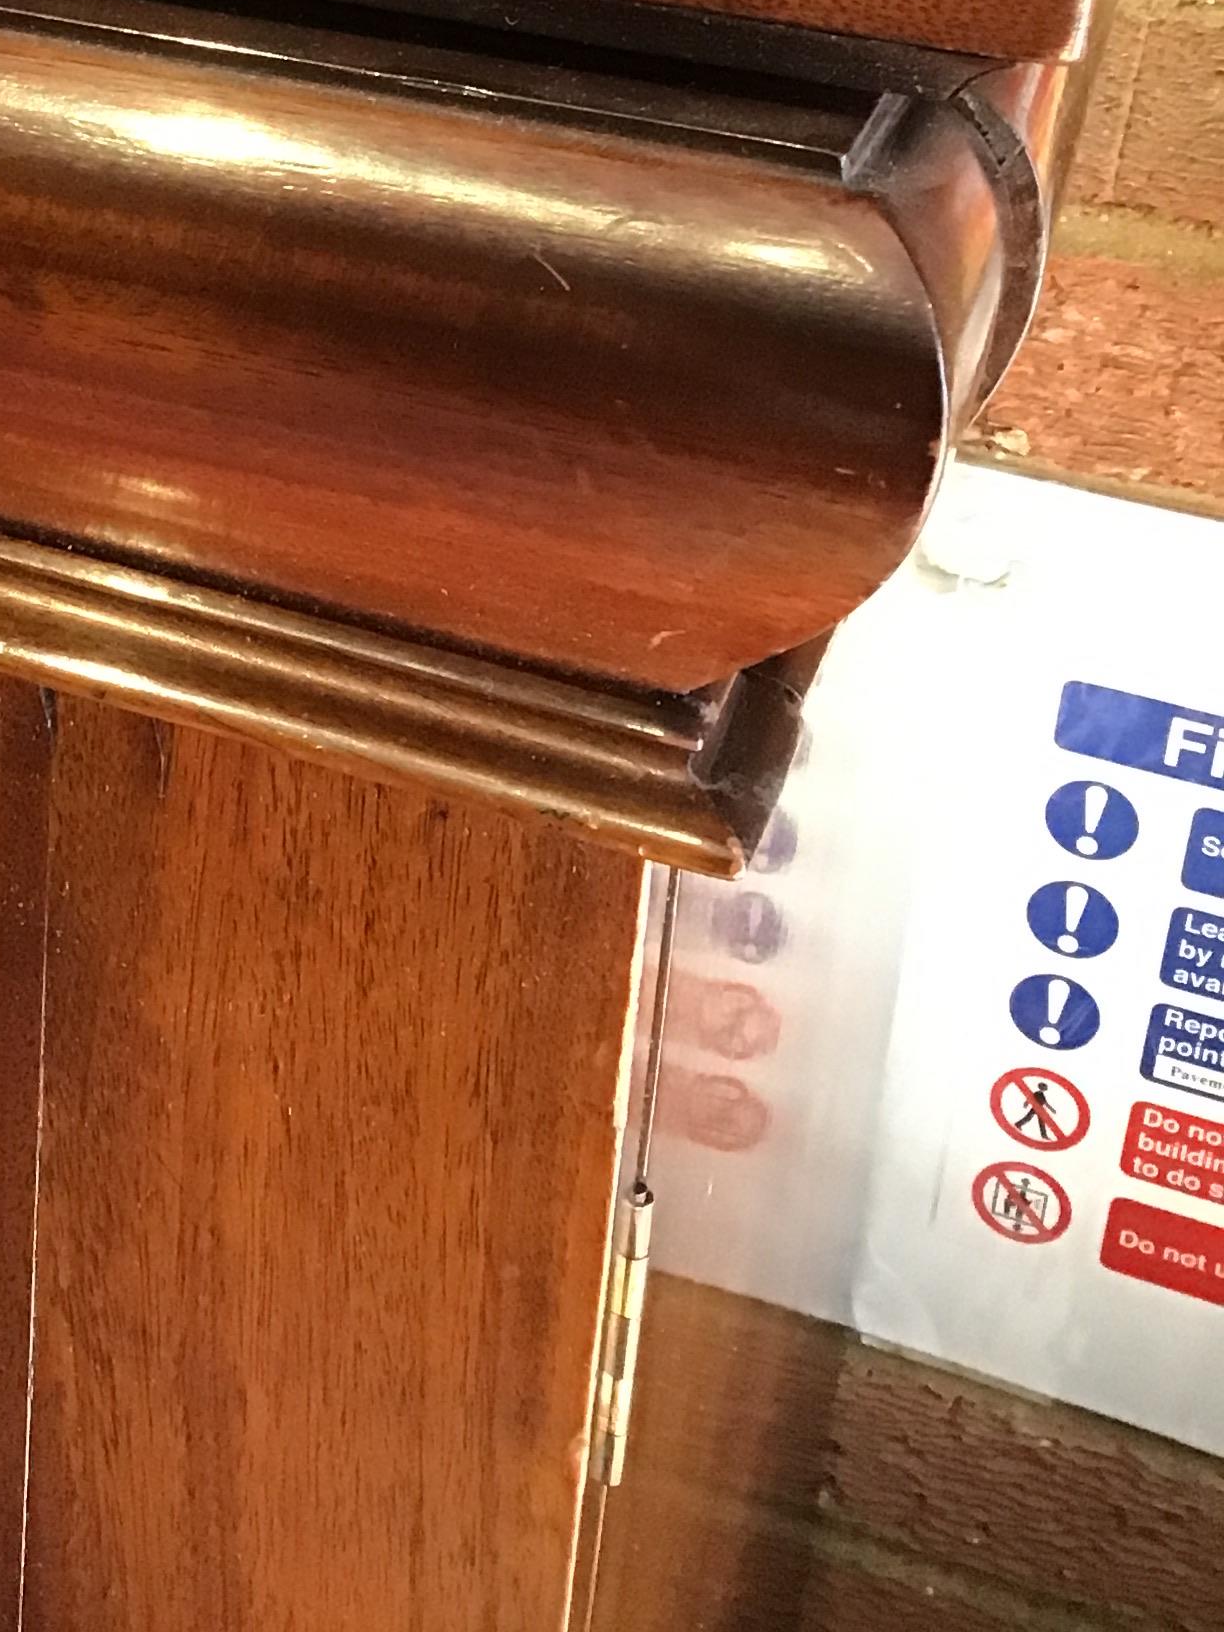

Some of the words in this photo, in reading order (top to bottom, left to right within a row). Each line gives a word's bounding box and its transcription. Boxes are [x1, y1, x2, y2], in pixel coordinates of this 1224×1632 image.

[1165, 717, 1224, 779] Fi
[1201, 835, 1224, 860] S
[1178, 938, 1213, 968] by
[1171, 1065, 1224, 1090] Pavem
[1143, 1107, 1180, 1134] Do
[1188, 1124, 1224, 1147] no
[1133, 1155, 1159, 1178] to
[1166, 1169, 1201, 1191] do
[1208, 1182, 1224, 1199] s
[1119, 1229, 1155, 1255] Do
[1163, 1246, 1207, 1273] not
